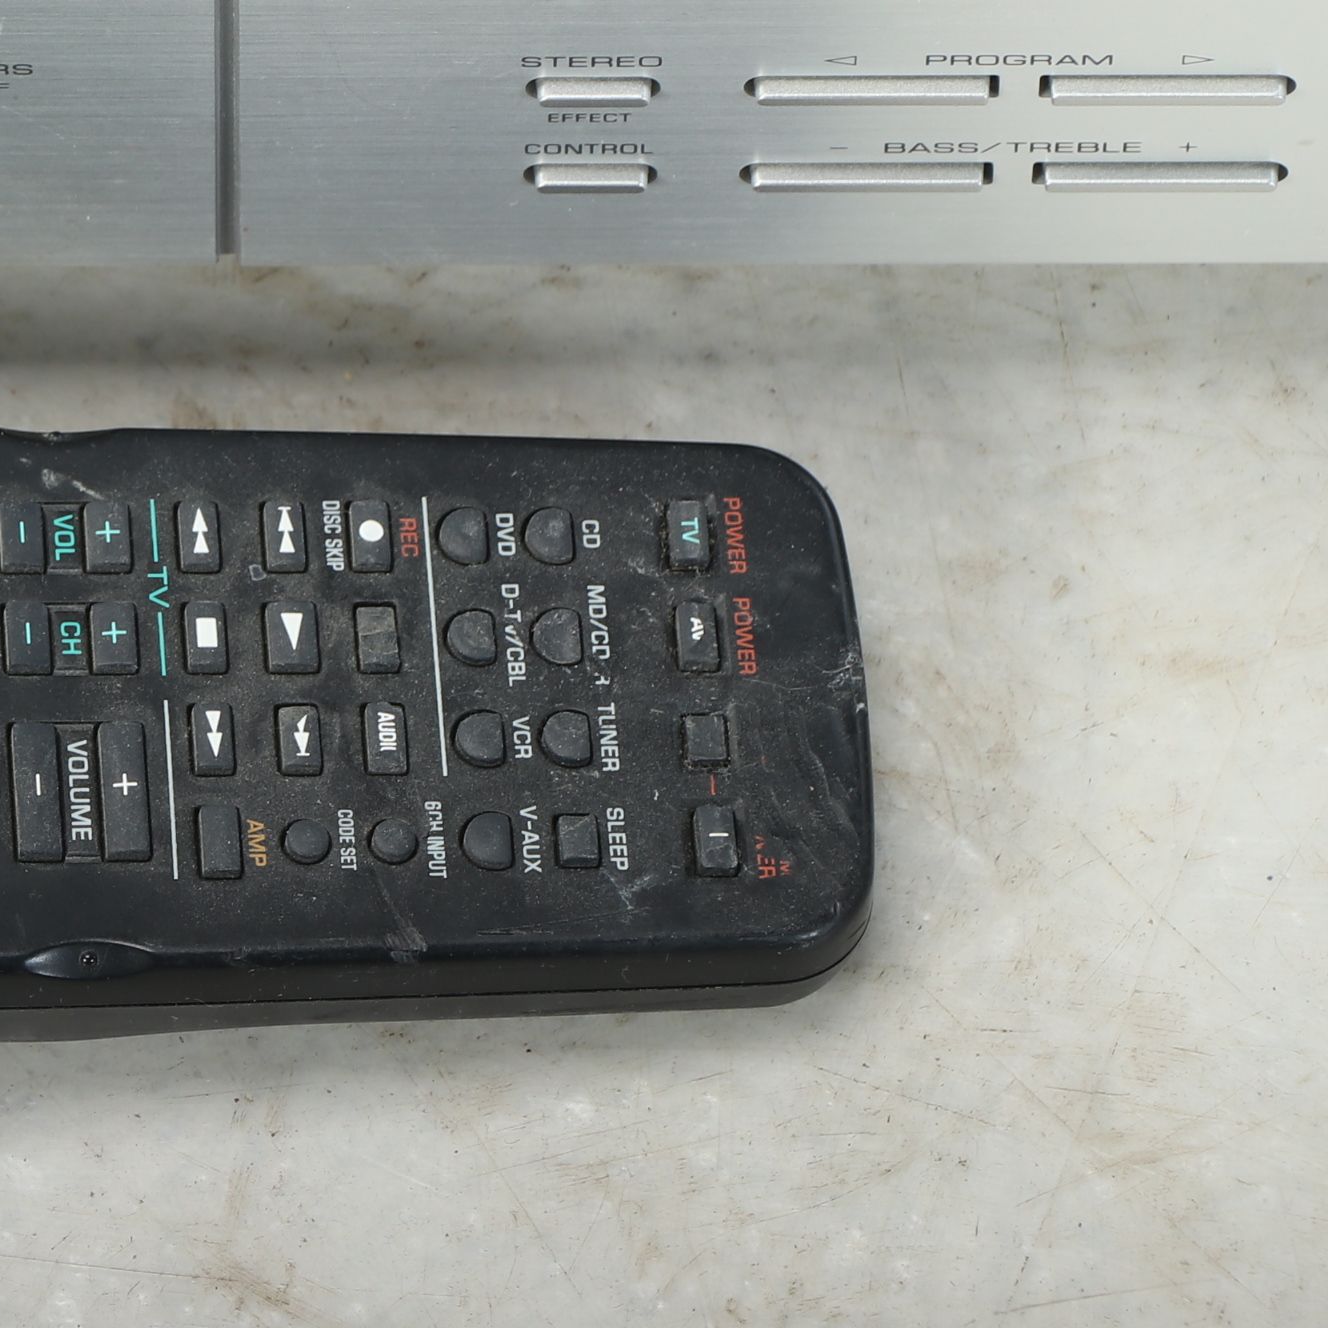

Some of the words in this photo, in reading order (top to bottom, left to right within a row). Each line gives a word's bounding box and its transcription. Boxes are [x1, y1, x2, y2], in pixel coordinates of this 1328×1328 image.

[521, 56, 663, 68] STEREO
[925, 54, 1114, 66] PROGRAM
[548, 113, 631, 123] EFFECT
[524, 143, 654, 155] CONTROL
[883, 141, 1142, 154] BASS/TREBLE
[52, 514, 74, 561] VOL
[320, 500, 339, 535] DISC
[494, 513, 515, 556] DVD
[581, 519, 600, 549] CD
[680, 518, 698, 543] TV
[723, 497, 746, 574] POWER
[323, 539, 344, 572] SKIP
[398, 518, 418, 558] REC
[146, 566, 168, 609] TV
[59, 621, 81, 655] CH
[731, 597, 756, 675] POWER
[511, 716, 531, 759] VCR
[597, 702, 620, 772] TUNER
[65, 739, 92, 841] VOLUME
[245, 819, 266, 867] AMP
[336, 809, 354, 843] CODE
[518, 806, 541, 874] V-AUX
[605, 807, 627, 871] SLEEP
[339, 847, 356, 871] SET
[426, 836, 446, 879] INPUT
